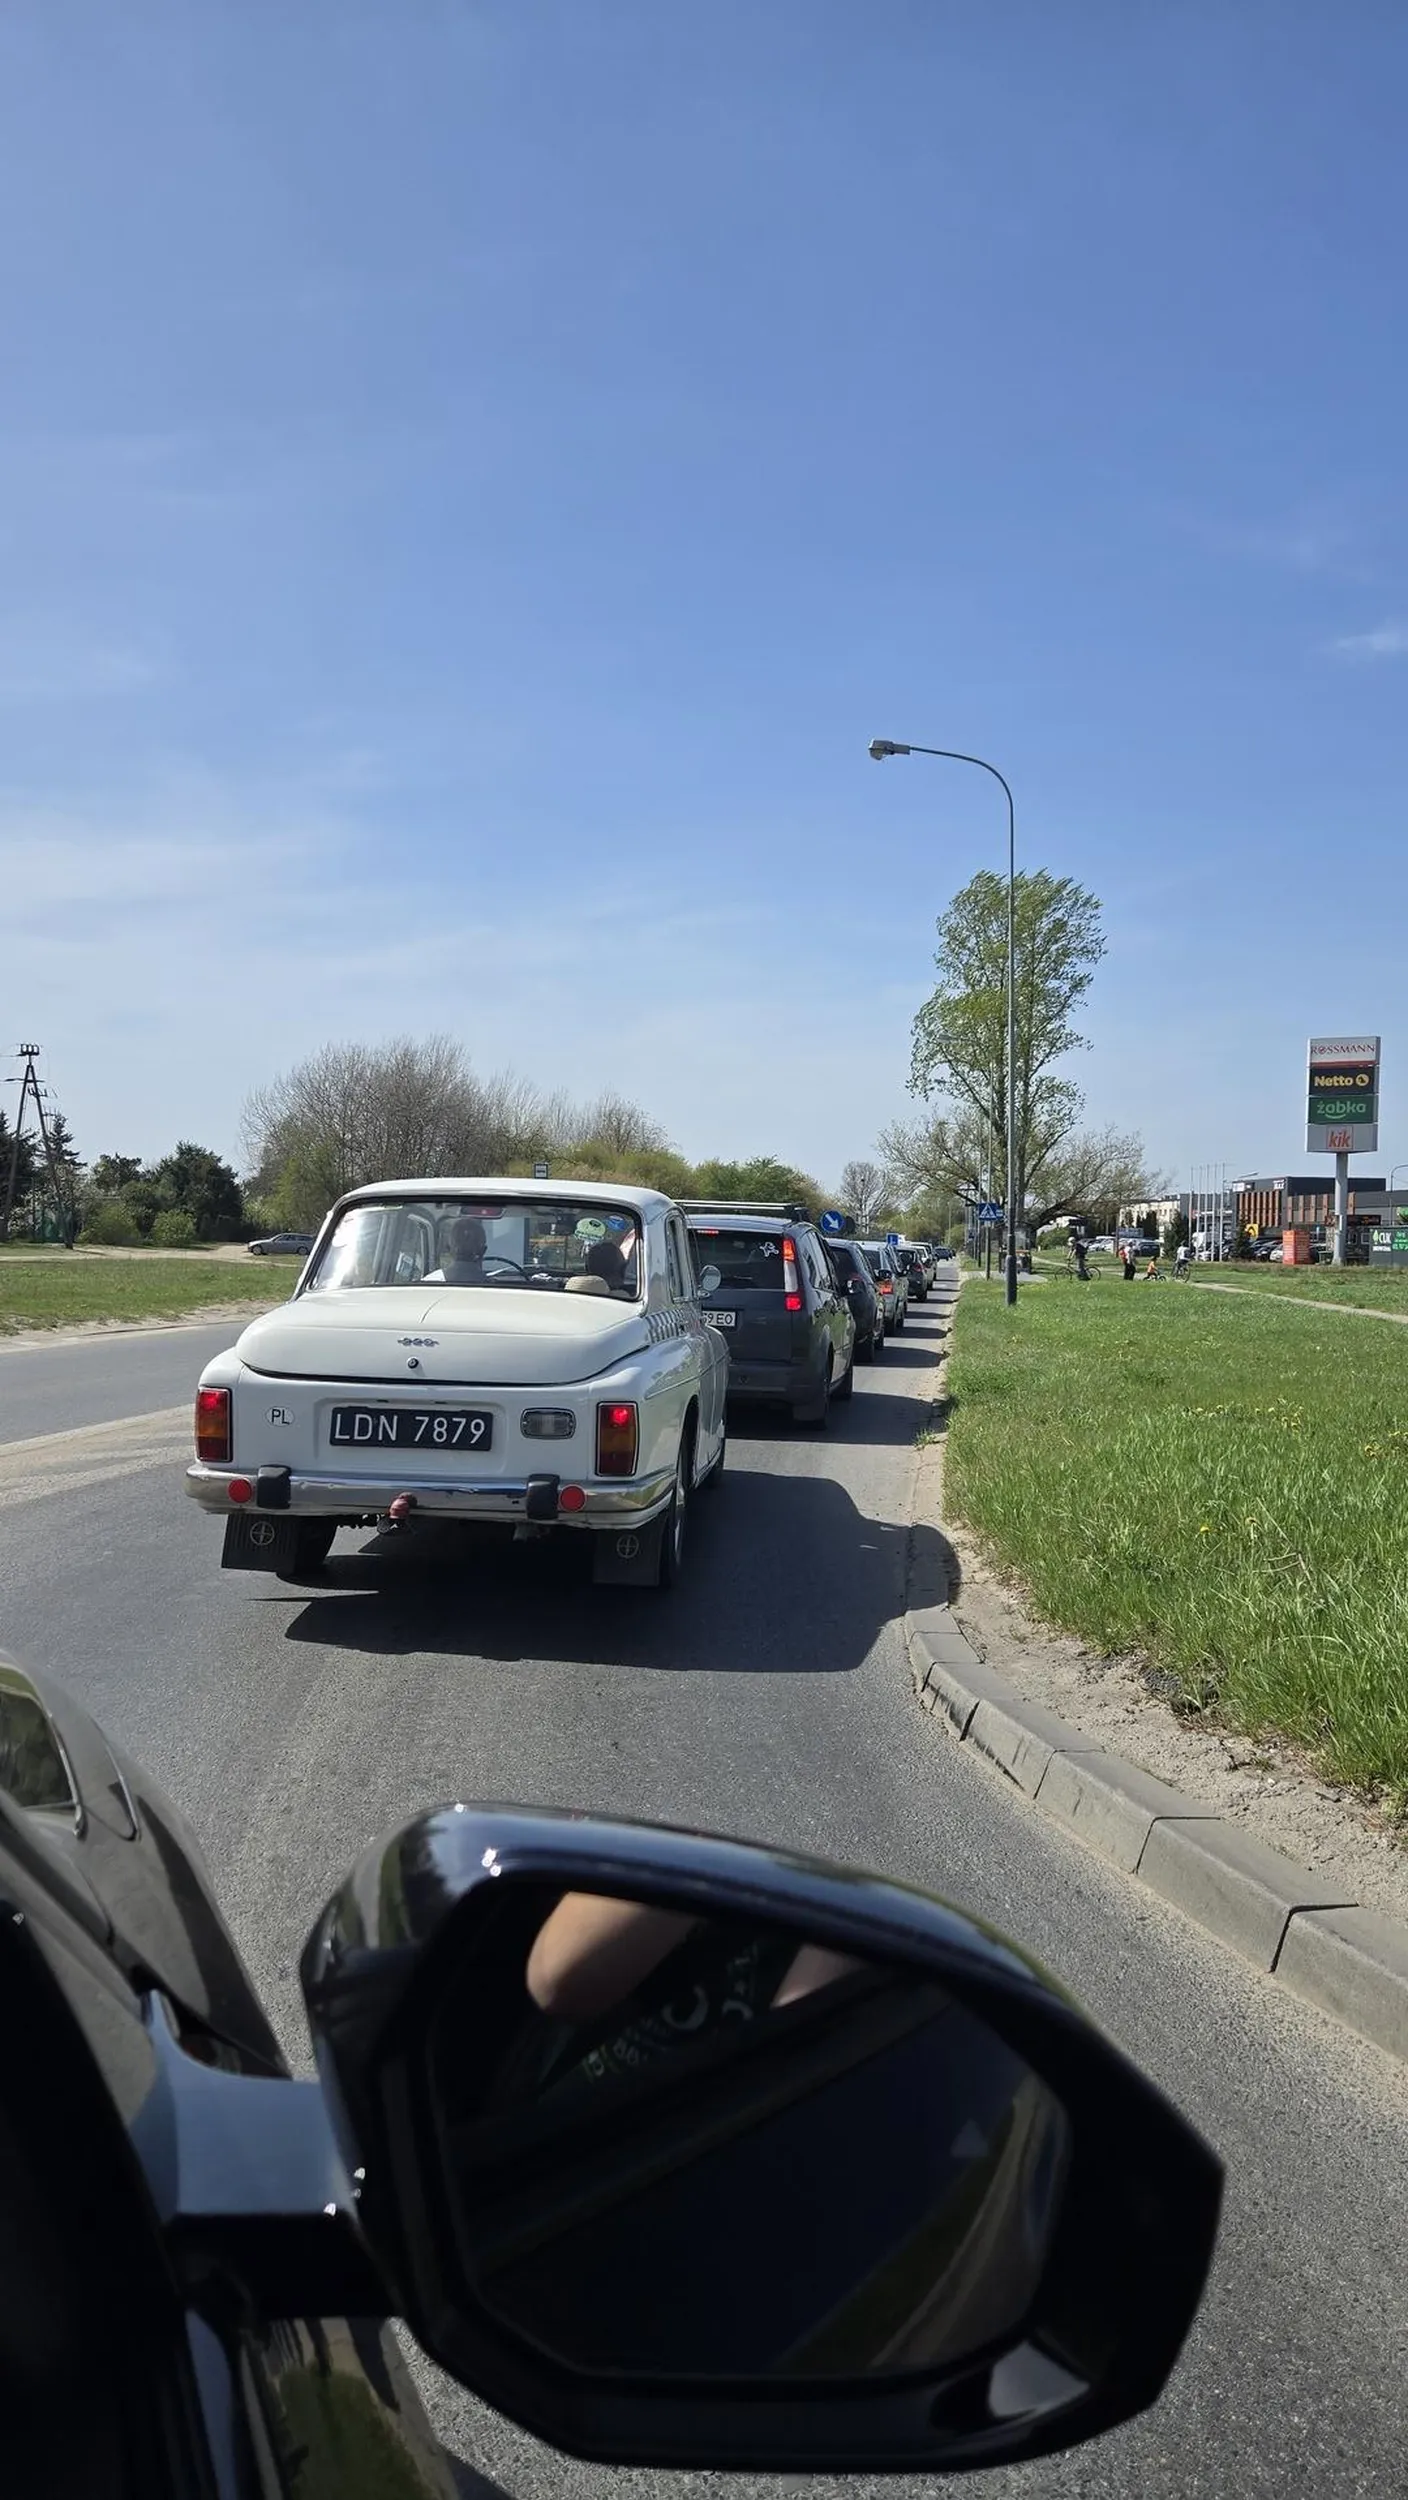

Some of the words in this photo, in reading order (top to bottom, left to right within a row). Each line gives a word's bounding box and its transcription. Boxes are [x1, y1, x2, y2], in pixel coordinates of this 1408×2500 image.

[1311, 1045, 1375, 1055] ROSSMANN
[1314, 1076, 1353, 1087] Netto
[1317, 1101, 1366, 1114] żabka
[271, 1408, 290, 1425] PL
[334, 1413, 398, 1441] LDN
[414, 1416, 485, 1444] 7879
